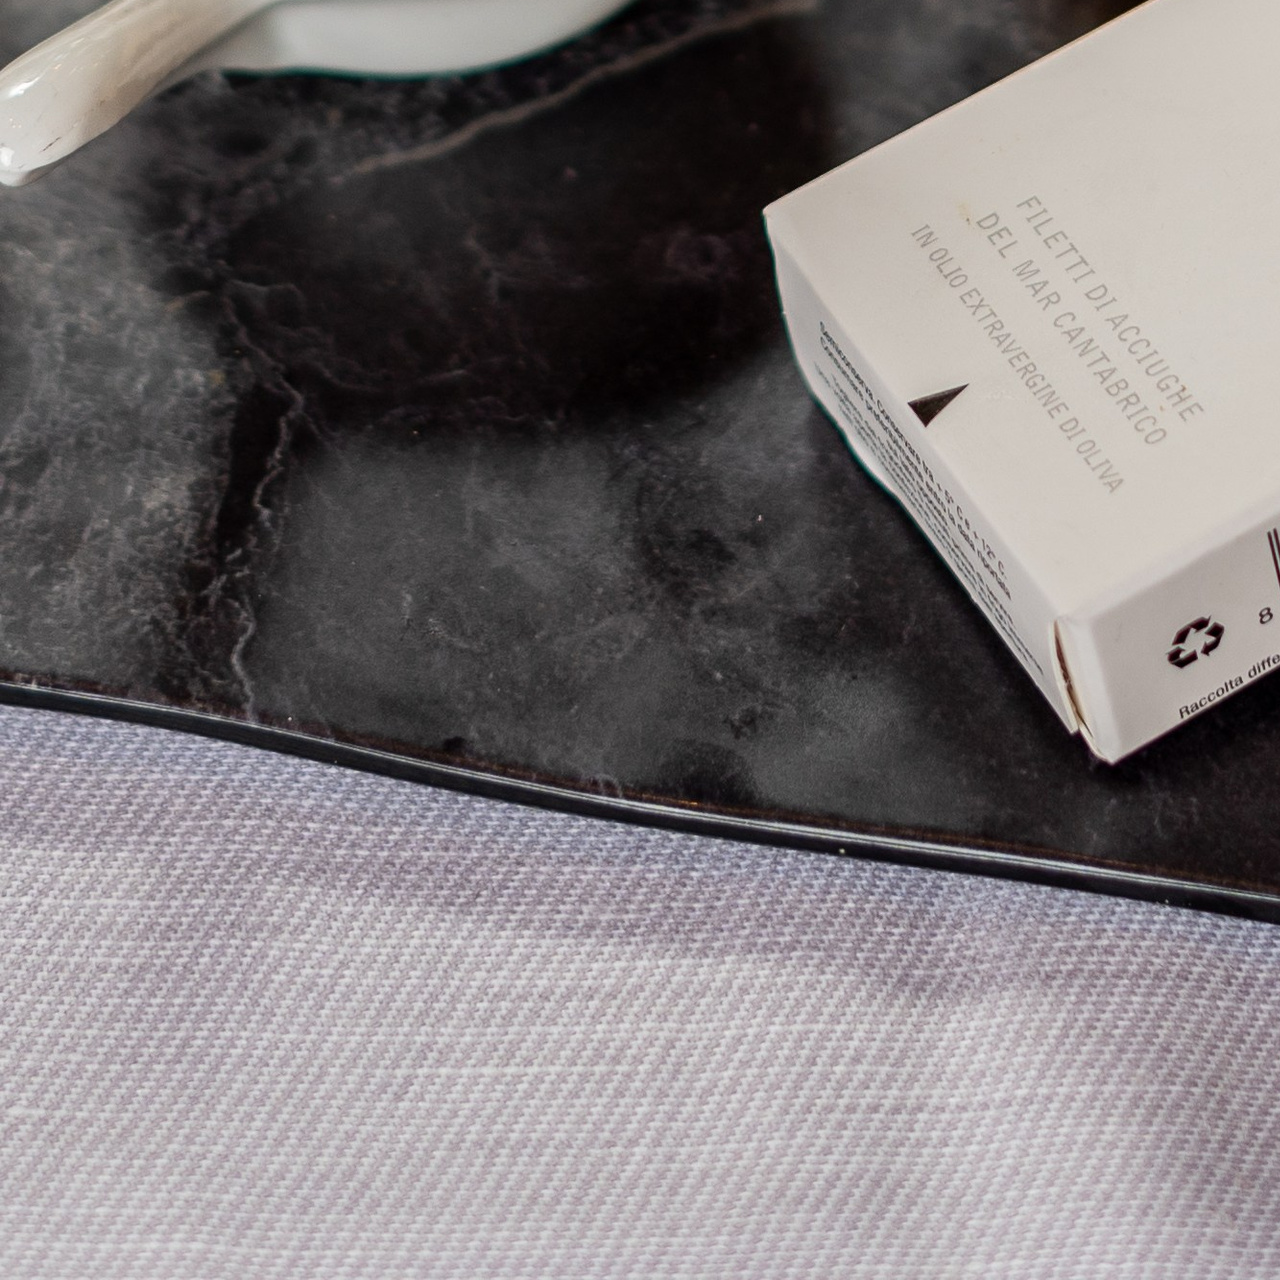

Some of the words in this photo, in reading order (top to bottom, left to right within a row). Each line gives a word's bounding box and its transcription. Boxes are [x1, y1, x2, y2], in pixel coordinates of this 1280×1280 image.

[910, 224, 939, 249] IN
[928, 247, 968, 288] OLIO
[958, 287, 1070, 420] EXTRAVERGINE
[1058, 416, 1087, 441] DI
[1075, 439, 1125, 494] OLIVA
[975, 212, 1018, 259] DEL
[1011, 259, 1061, 312] MAR
[1053, 311, 1168, 445] CANTABRICO
[1016, 195, 1096, 284] FILETTI
[1083, 283, 1118, 312] DI
[1104, 313, 1205, 423] ACCIUGHE
[1178, 676, 1244, 720] Raccolta
[1258, 603, 1273, 627] 8
